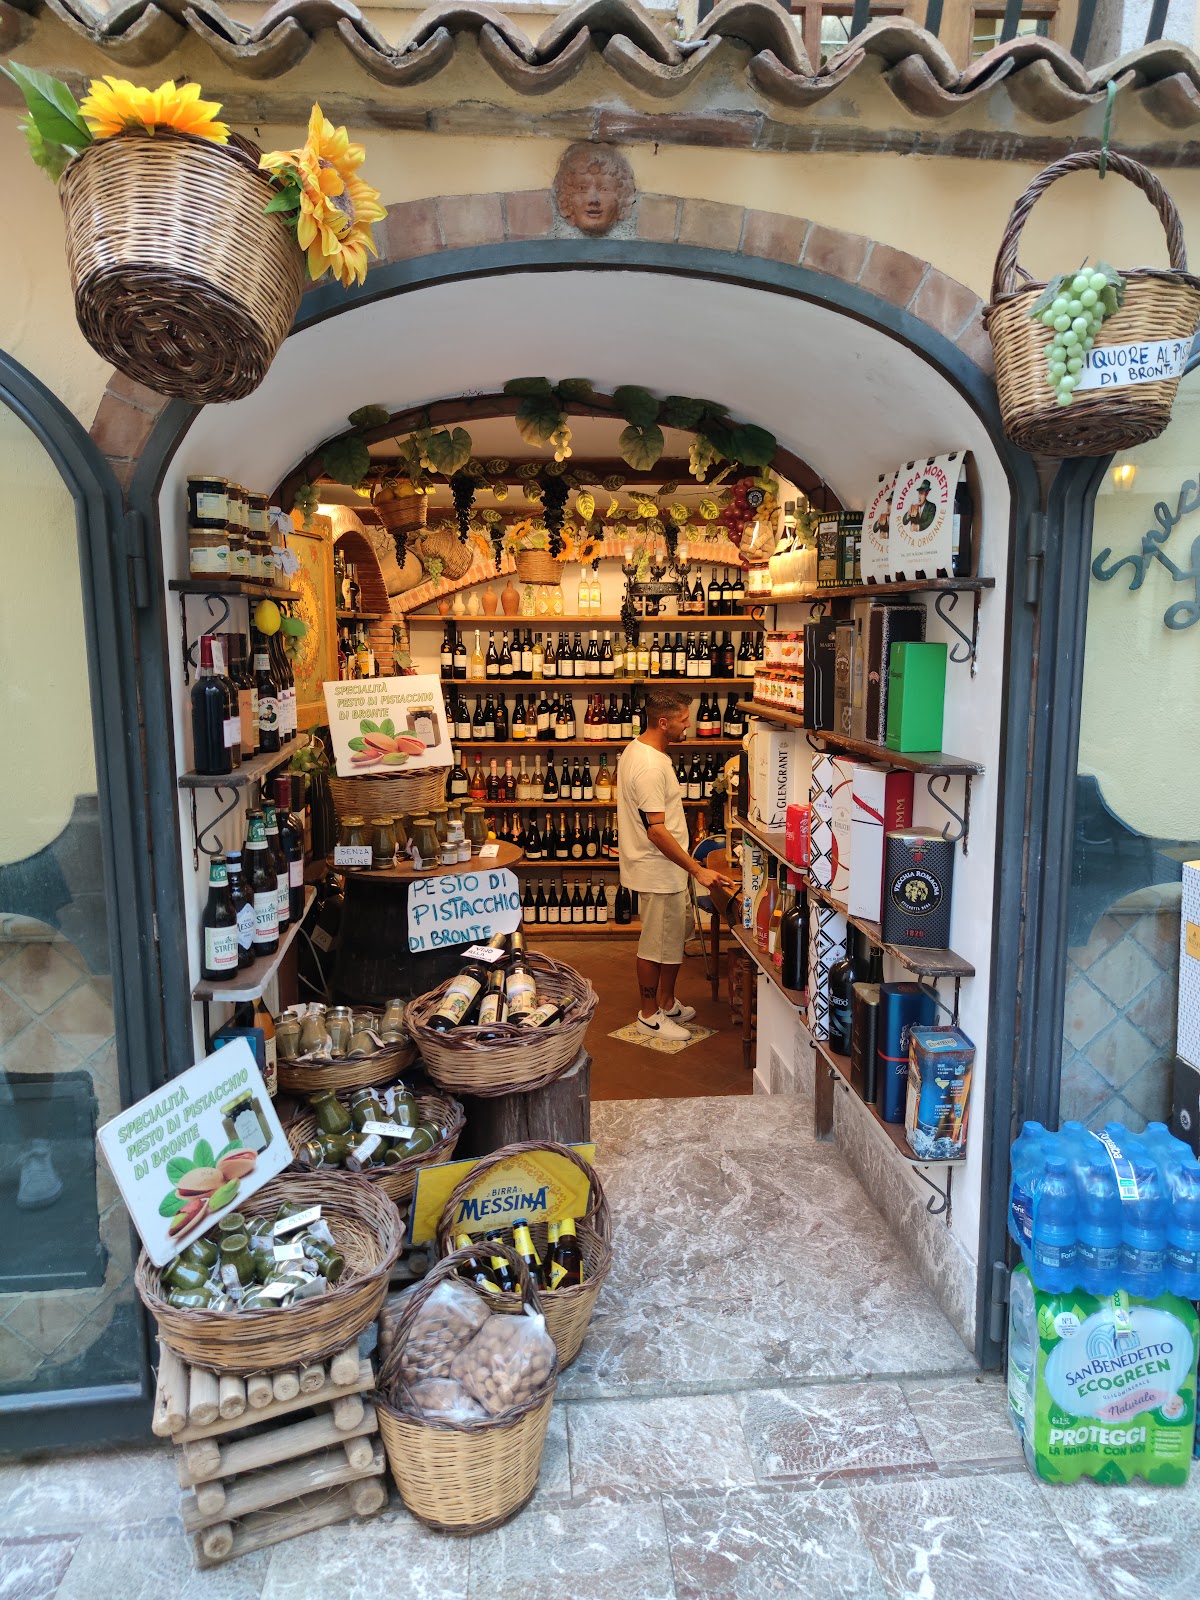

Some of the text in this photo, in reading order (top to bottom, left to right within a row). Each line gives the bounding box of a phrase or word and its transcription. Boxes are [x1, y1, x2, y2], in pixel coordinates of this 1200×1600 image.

[1081, 346, 1149, 369] IQUORE
[1156, 346, 1170, 363] AL
[1100, 372, 1118, 385] DI
[896, 465, 948, 511] BIRRA MORETTI
[868, 484, 890, 519] BIRRA
[896, 508, 947, 548] RICETTA ORIGINALE
[334, 681, 388, 696] SPECIALITÀ
[337, 691, 434, 708] PESTO DI PISTACCHIO
[338, 707, 390, 720] DI BRONTE
[340, 847, 370, 855] SENZA
[413, 872, 507, 898] PESTO DI
[893, 871, 915, 892] VECCHIA
[411, 891, 521, 925] PISTACCHIO
[409, 925, 492, 951] DI BRONTE
[118, 1085, 189, 1144] SPECIALITÀ
[126, 1068, 249, 1162] PESTO DI PISTACCHIO
[133, 1123, 200, 1181] DI BRONTE
[491, 1185, 518, 1197] BIRRA
[456, 1185, 550, 1224] MESSINA
[1077, 1358, 1171, 1398] ECOGREEN
[1102, 1379, 1151, 1400] OLIGOMINERALE
[1108, 1391, 1157, 1416] Naturale
[1049, 1425, 1147, 1447] PROTEGGI
[1049, 1443, 1146, 1456] LA NATURA CON NOI
